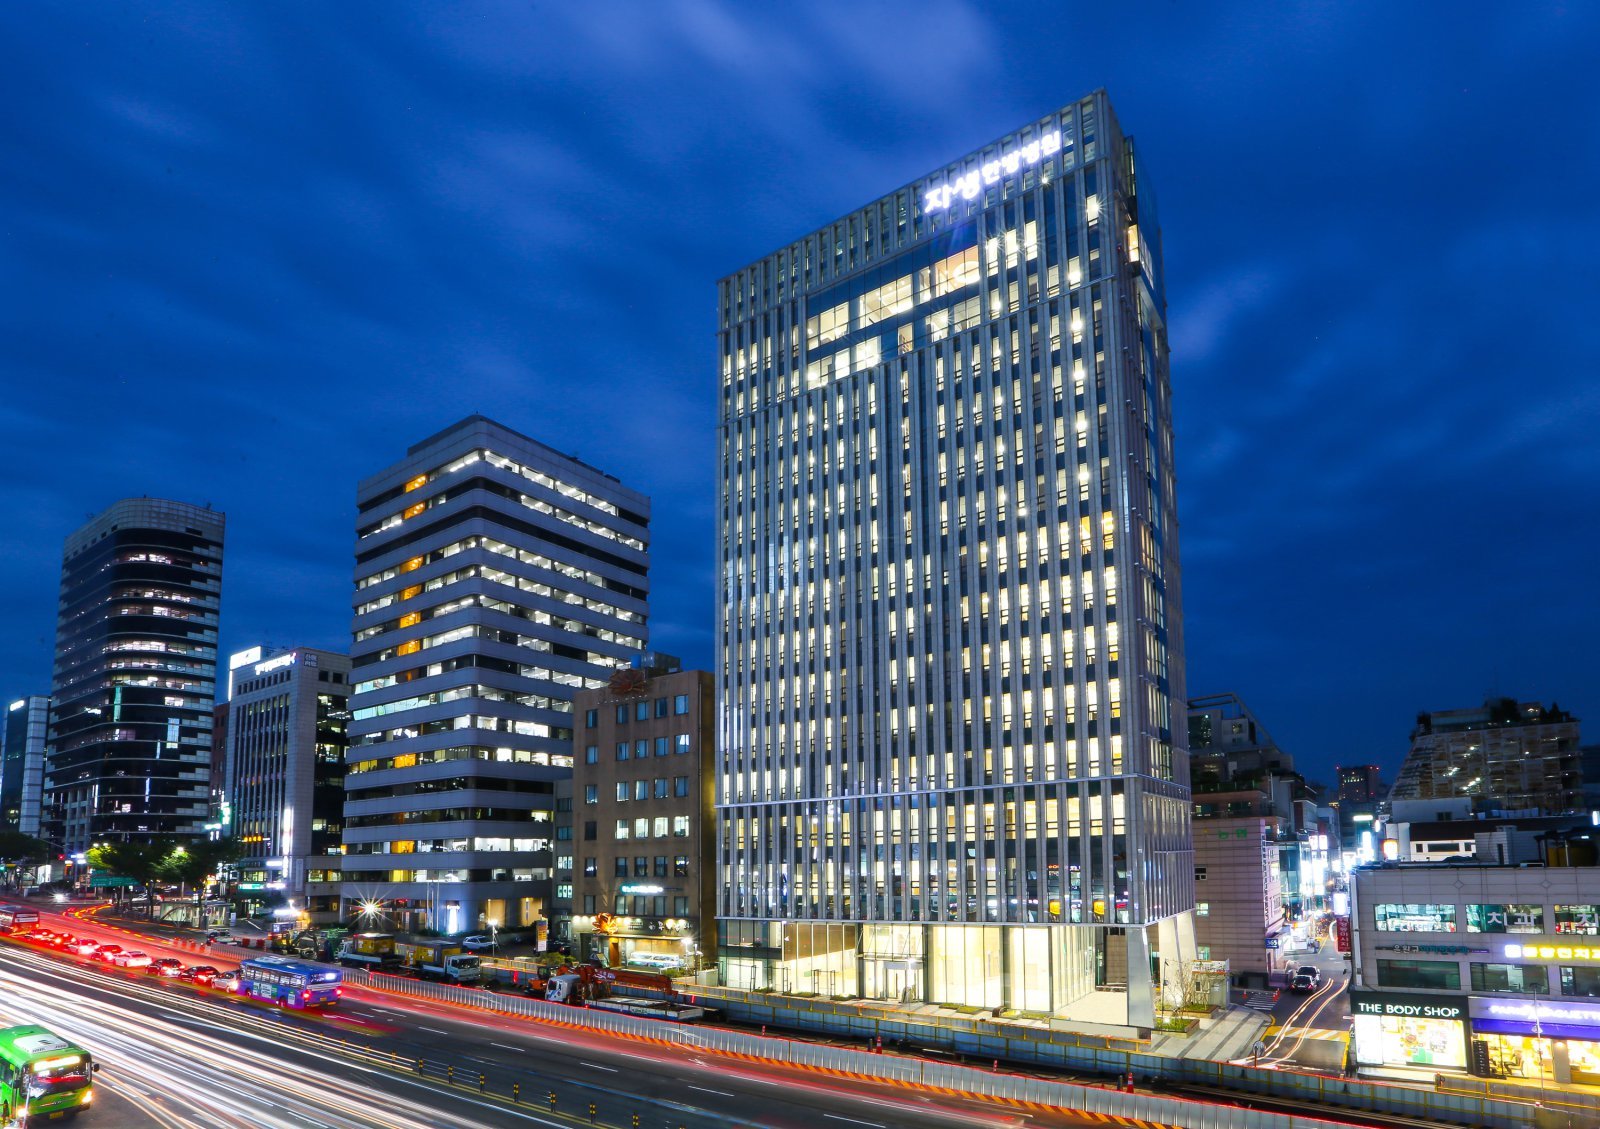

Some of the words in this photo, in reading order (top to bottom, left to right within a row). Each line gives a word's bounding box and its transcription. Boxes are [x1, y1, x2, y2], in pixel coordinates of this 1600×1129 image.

[1487, 912, 1537, 927] 치과
[1358, 1002, 1382, 1013] THE
[1386, 1004, 1421, 1015] BODY
[1424, 1006, 1460, 1017] SHOP
